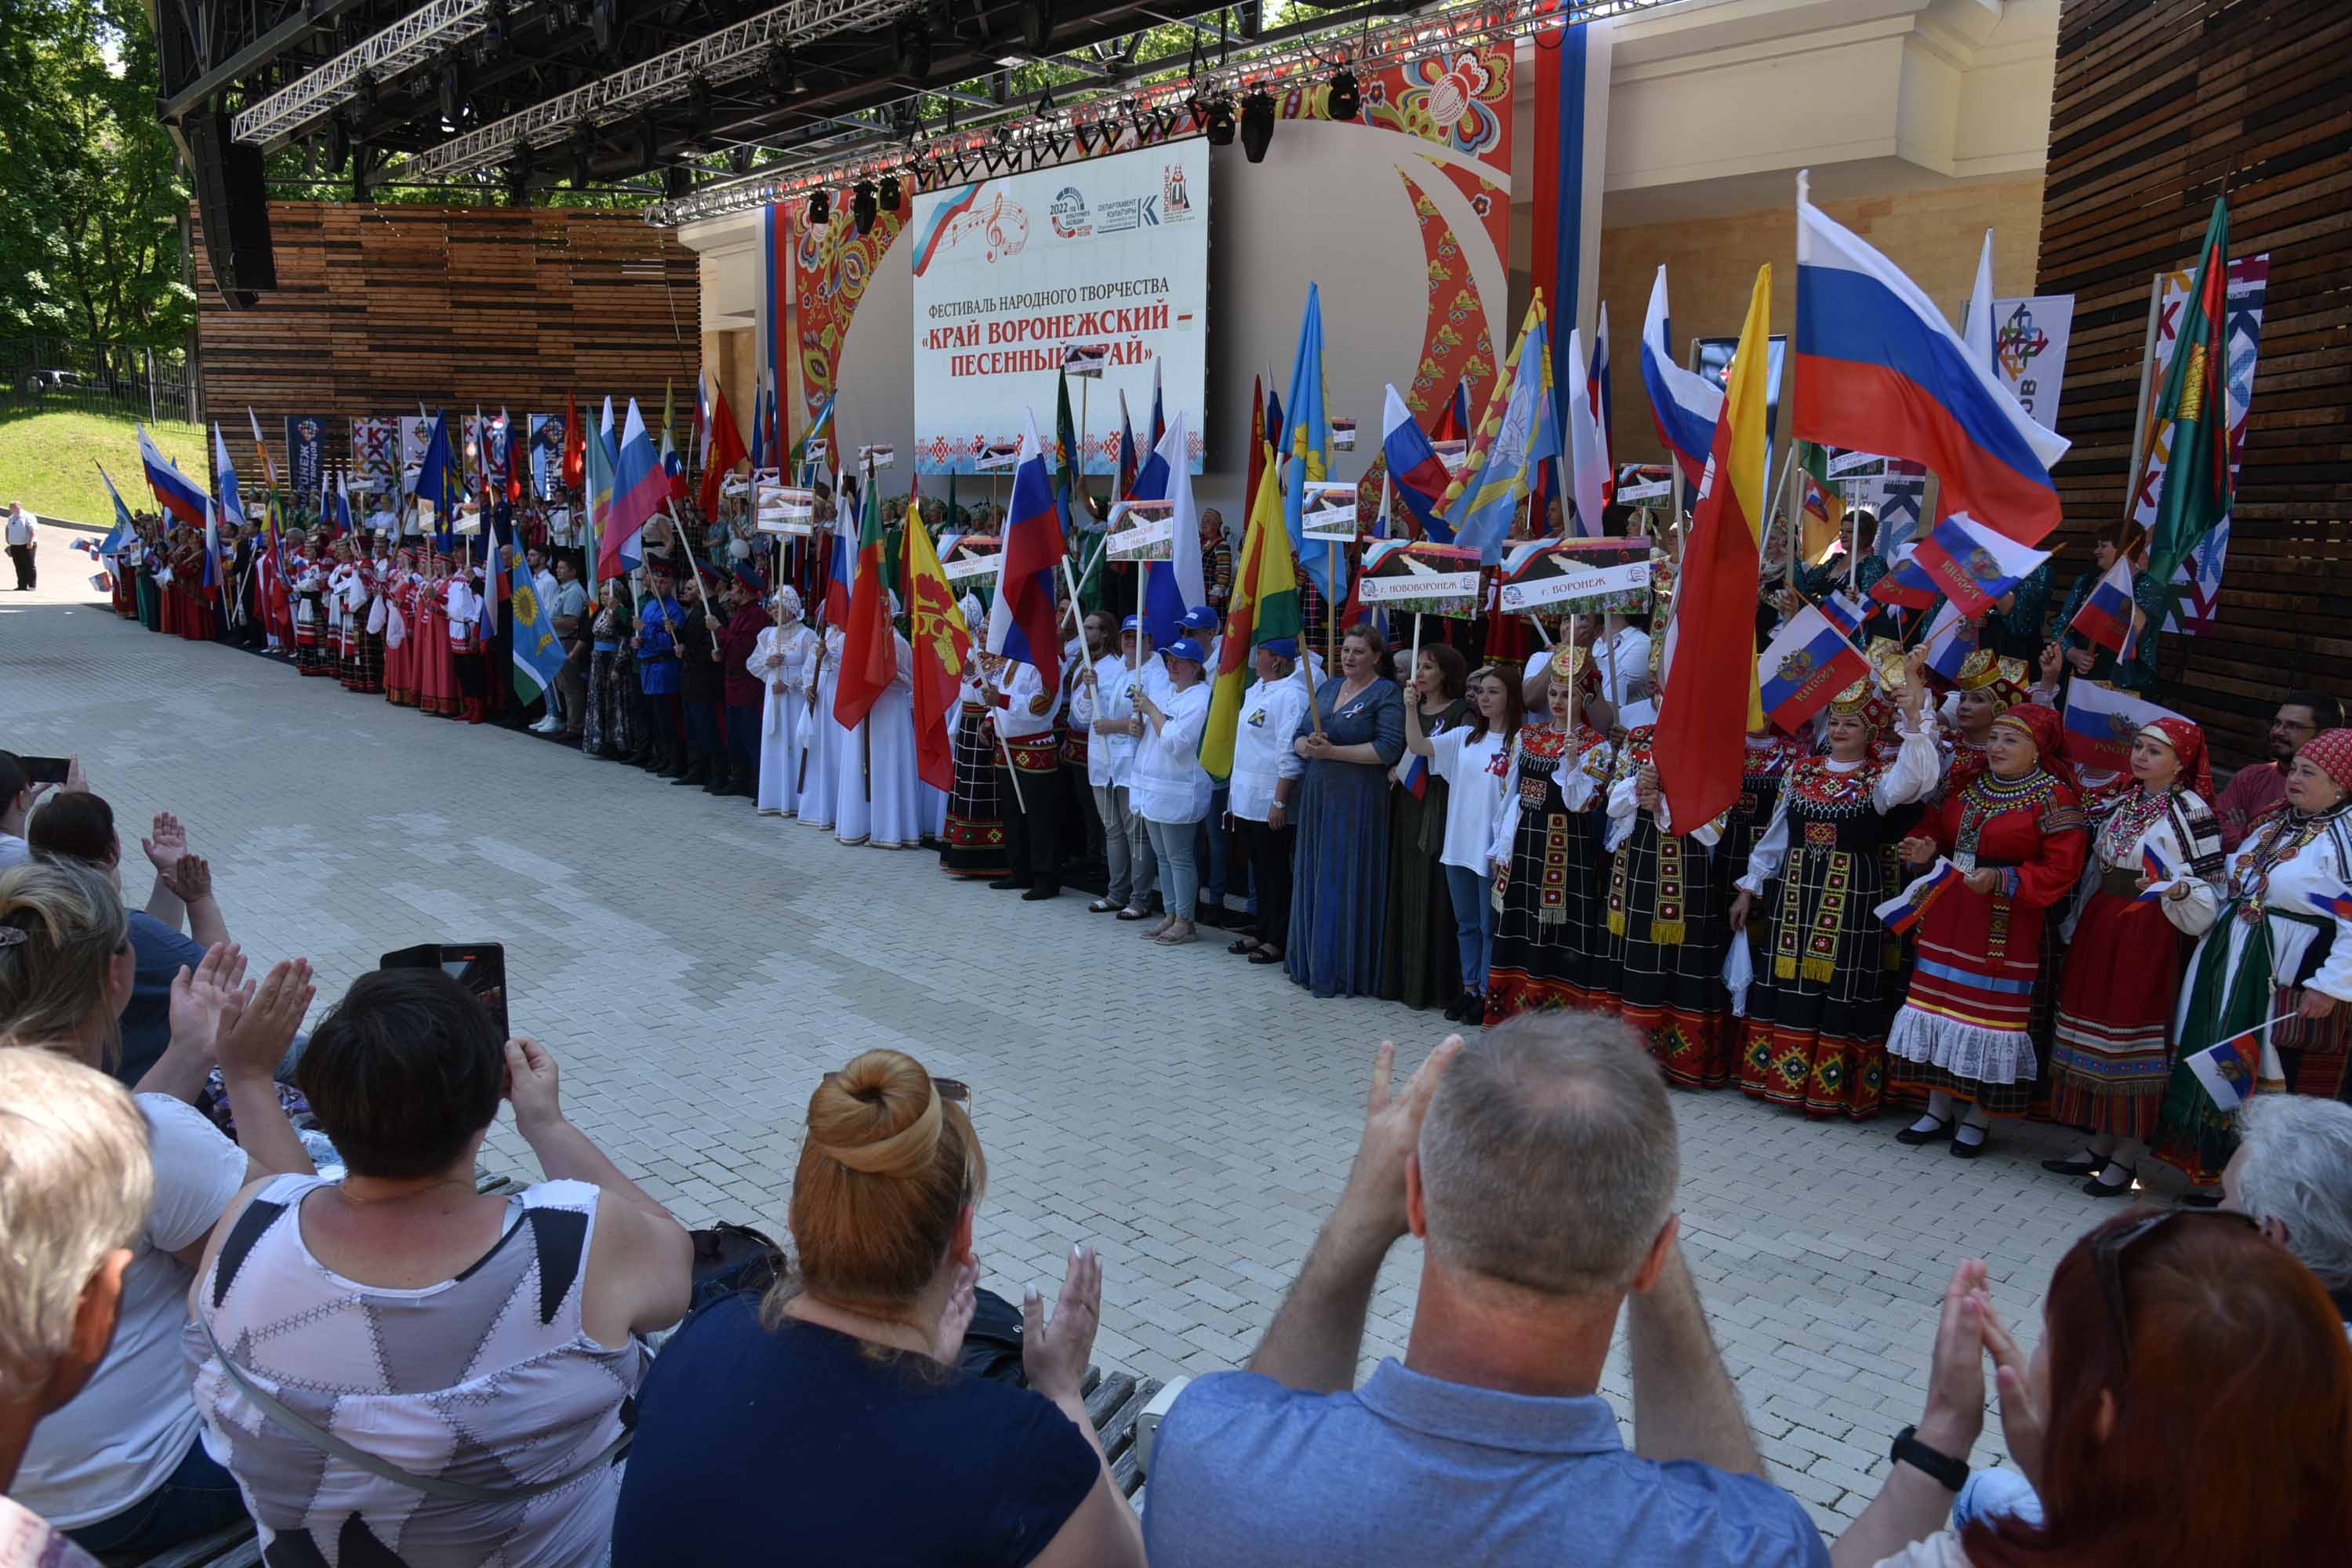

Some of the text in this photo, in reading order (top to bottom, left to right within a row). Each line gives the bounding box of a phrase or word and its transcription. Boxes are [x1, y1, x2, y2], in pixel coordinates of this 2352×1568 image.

[1050, 202, 1068, 215] 2022
[928, 277, 1169, 319] ФЕСТИВАЛЬ НАРОДНОГО ТВОРЧЕСТВА
[922, 319, 980, 350] «КРАЙ
[988, 299, 1169, 344] ВОРОНЕЖСКИЙ
[1389, 581, 1457, 593] НОВОВОРОНЕЖ
[1552, 576, 1606, 594] ВОРОНЕЖ
